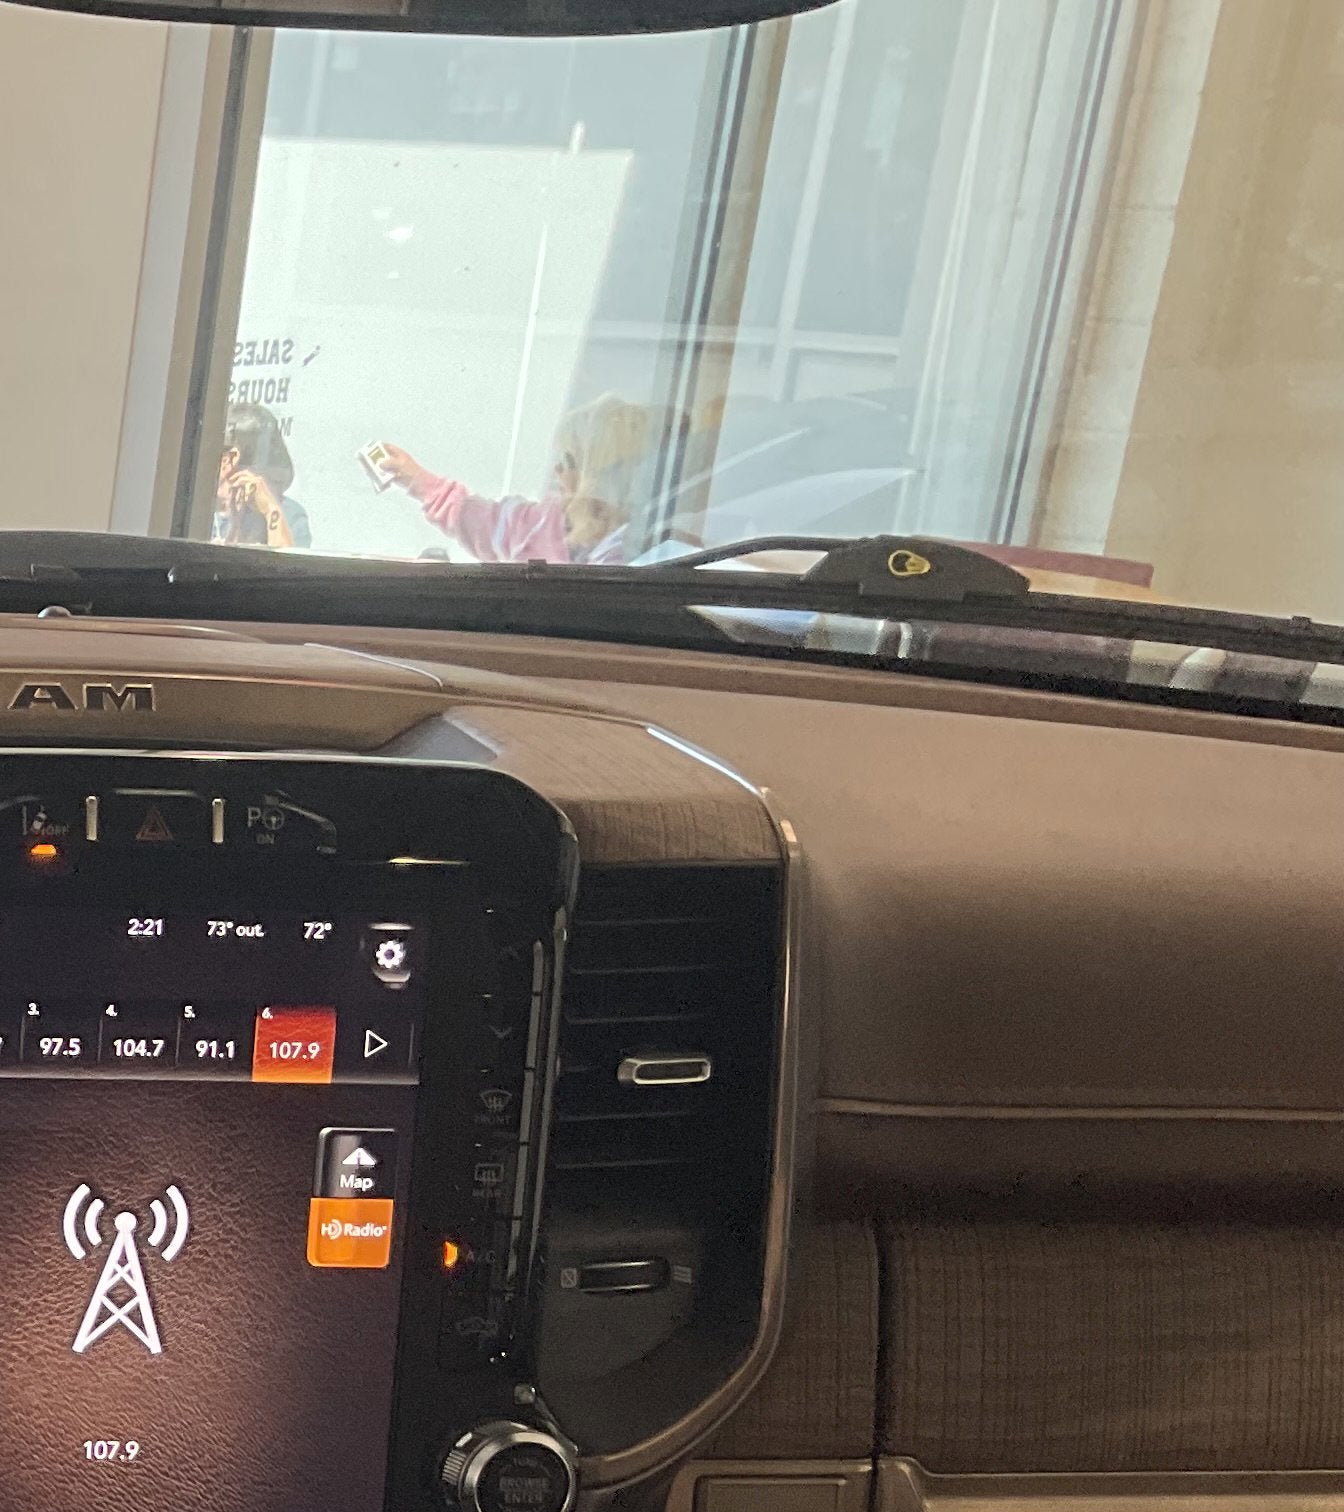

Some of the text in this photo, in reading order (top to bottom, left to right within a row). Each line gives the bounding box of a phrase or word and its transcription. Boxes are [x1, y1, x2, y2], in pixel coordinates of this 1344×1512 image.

[127, 918, 163, 936] 2:21
[39, 1037, 81, 1056] 97.5
[113, 1039, 165, 1057] 104.7
[195, 1040, 236, 1058] 91.1
[269, 1041, 321, 1060] 107.9
[340, 1174, 375, 1191] Map
[82, 1440, 140, 1460] 107.9
